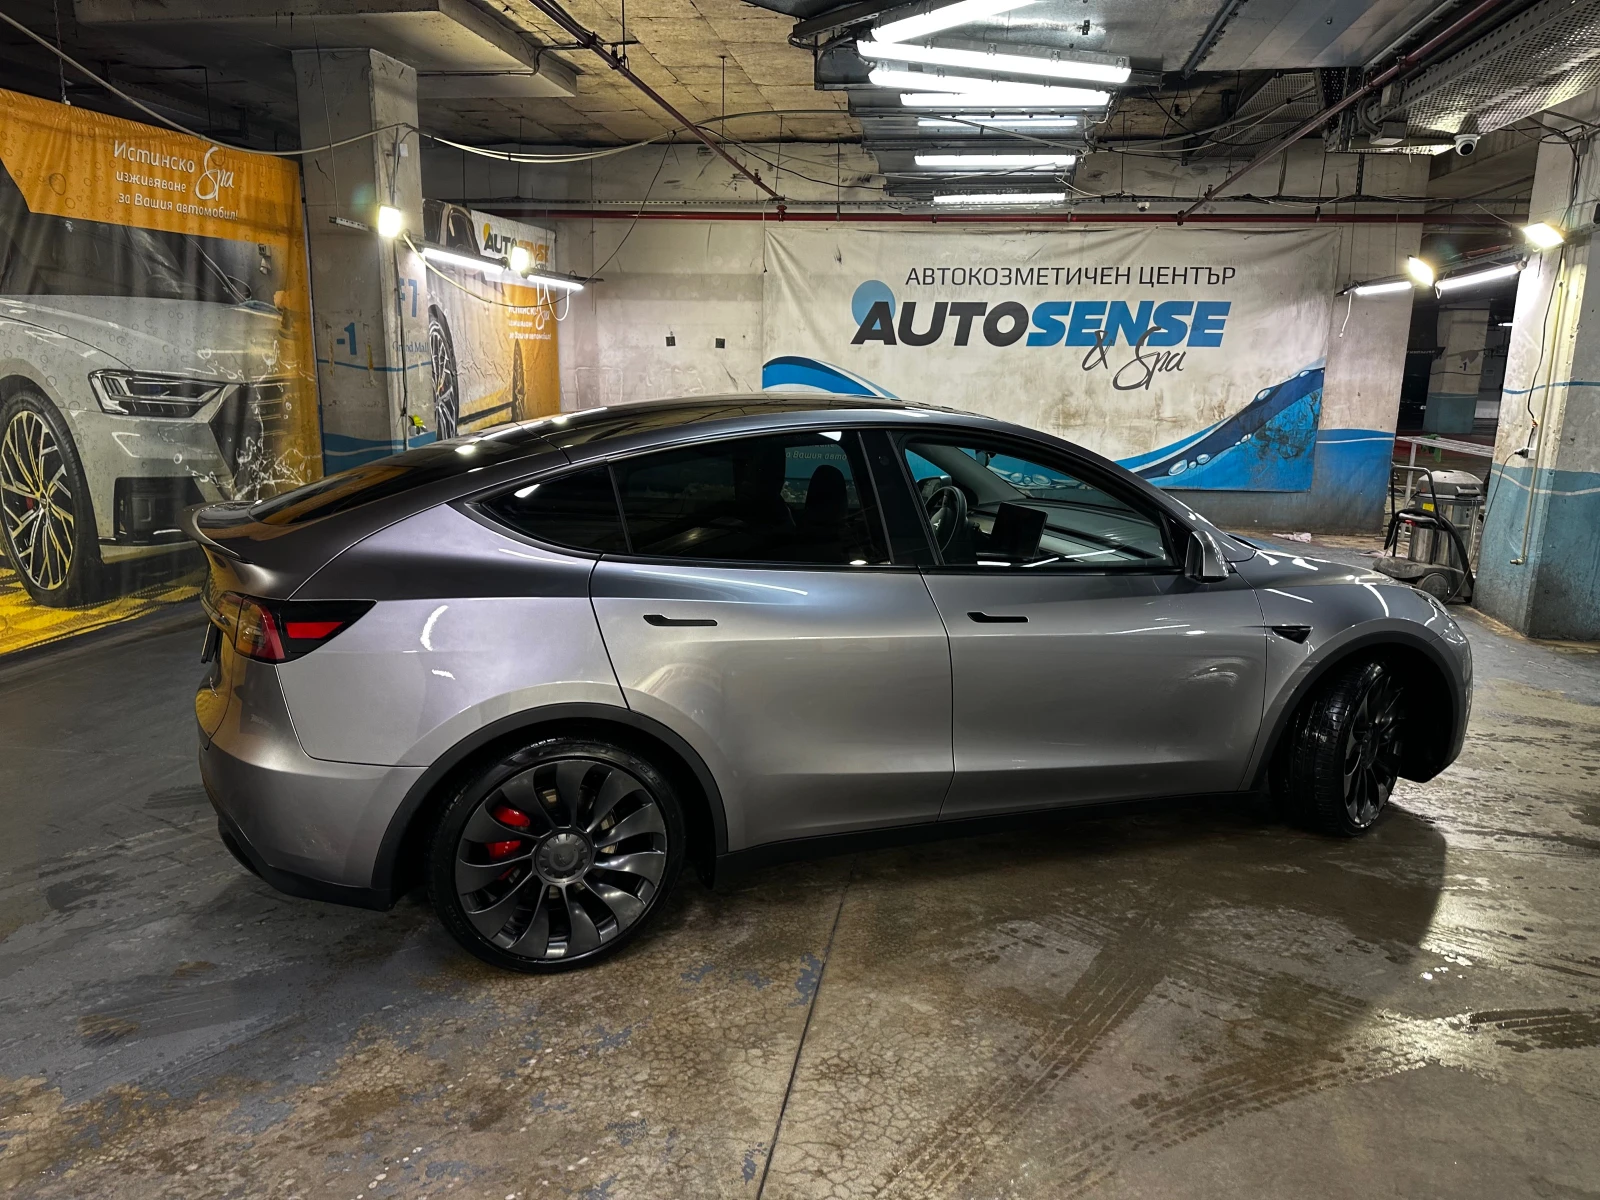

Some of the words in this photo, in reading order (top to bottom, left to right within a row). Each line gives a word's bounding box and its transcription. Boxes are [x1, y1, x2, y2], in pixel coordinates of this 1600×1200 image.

[113, 140, 195, 173] Истинско
[195, 146, 235, 202] Spa
[116, 170, 187, 193] изживяване
[118, 193, 131, 205] за
[134, 193, 173, 211] Вашия
[176, 202, 239, 221] автомобил!
[905, 266, 1131, 286] АВТОКОЗМЕТИЧЕН
[1138, 266, 1236, 287] ЦЕНТЪР
[336, 321, 358, 356] -1
[850, 300, 1232, 348] AUTOSENSE
[1081, 330, 1114, 372] &
[1112, 325, 1188, 391] Spa
[793, 450, 822, 460] Вашия
[824, 452, 848, 461] авто
